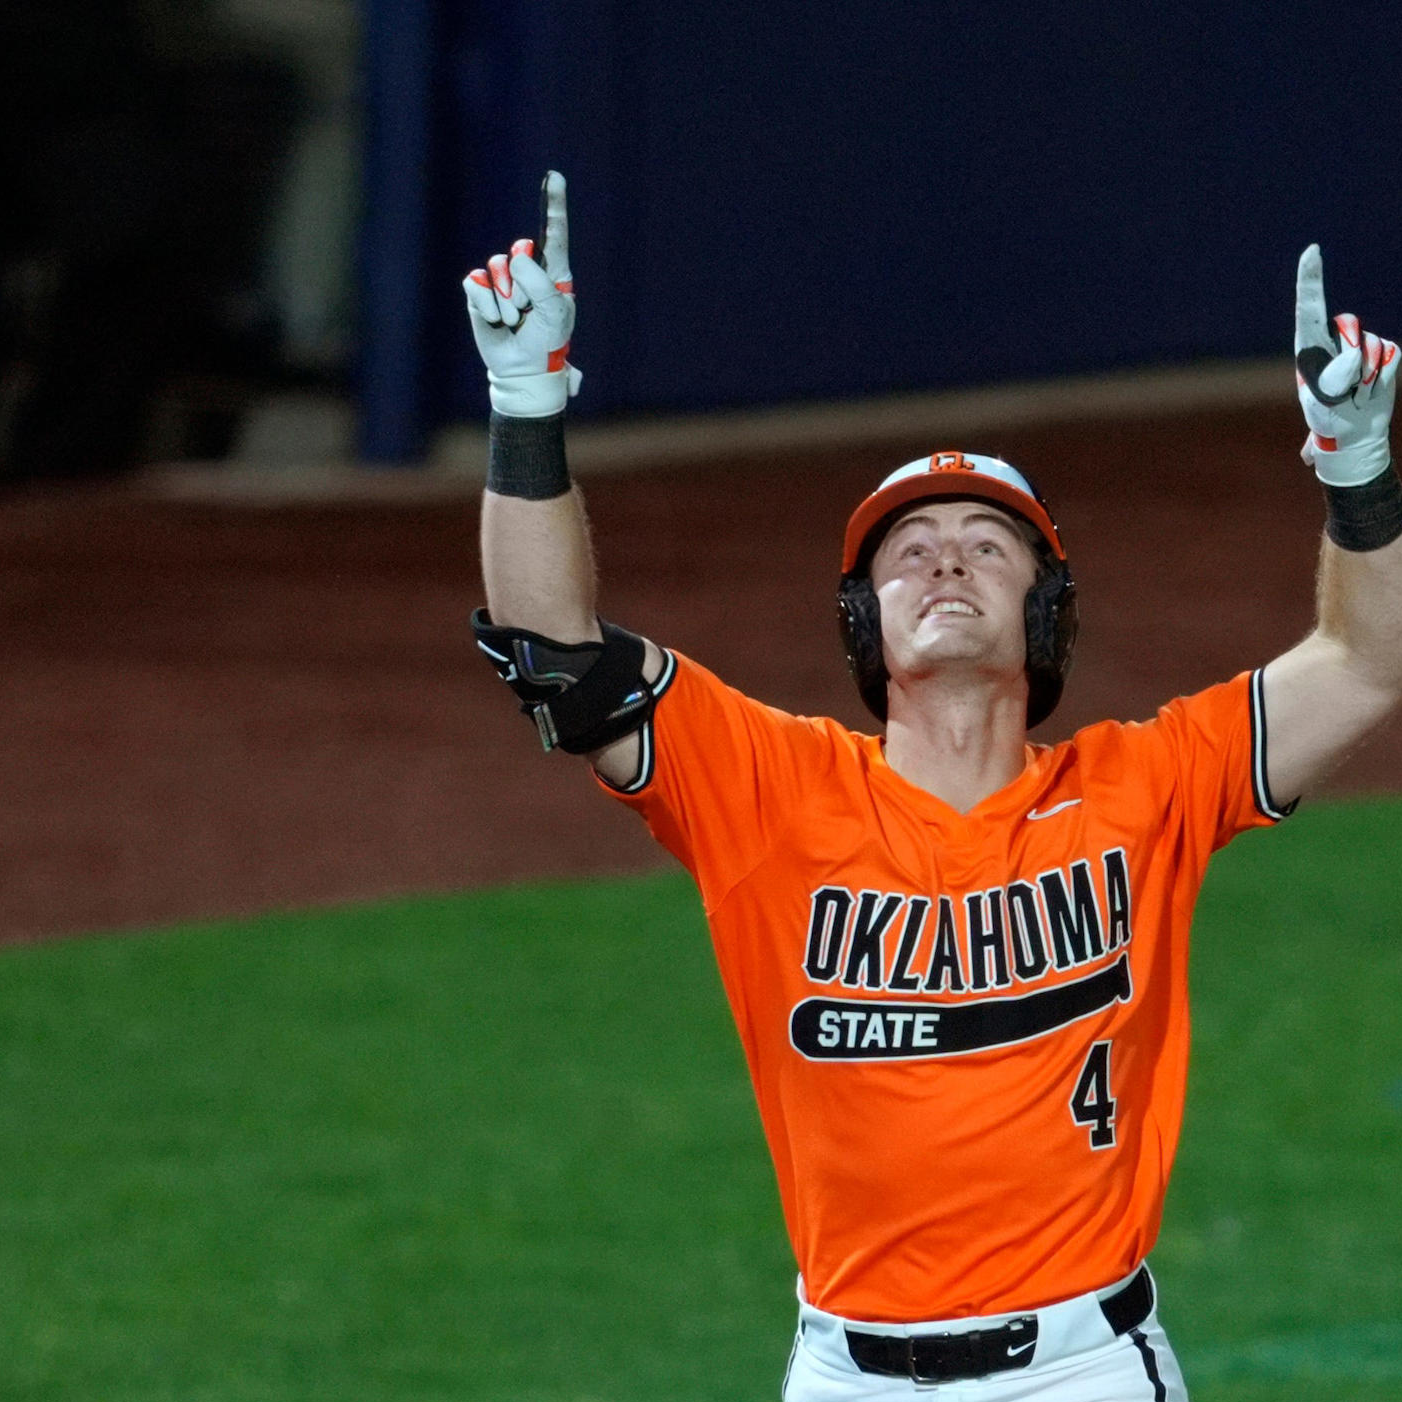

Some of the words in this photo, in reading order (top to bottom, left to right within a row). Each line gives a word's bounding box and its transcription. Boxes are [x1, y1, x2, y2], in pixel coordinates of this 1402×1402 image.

[802, 847, 1132, 993] OKLAHOMA
[818, 1011, 939, 1048] STATE
[1069, 1039, 1117, 1151] 4
